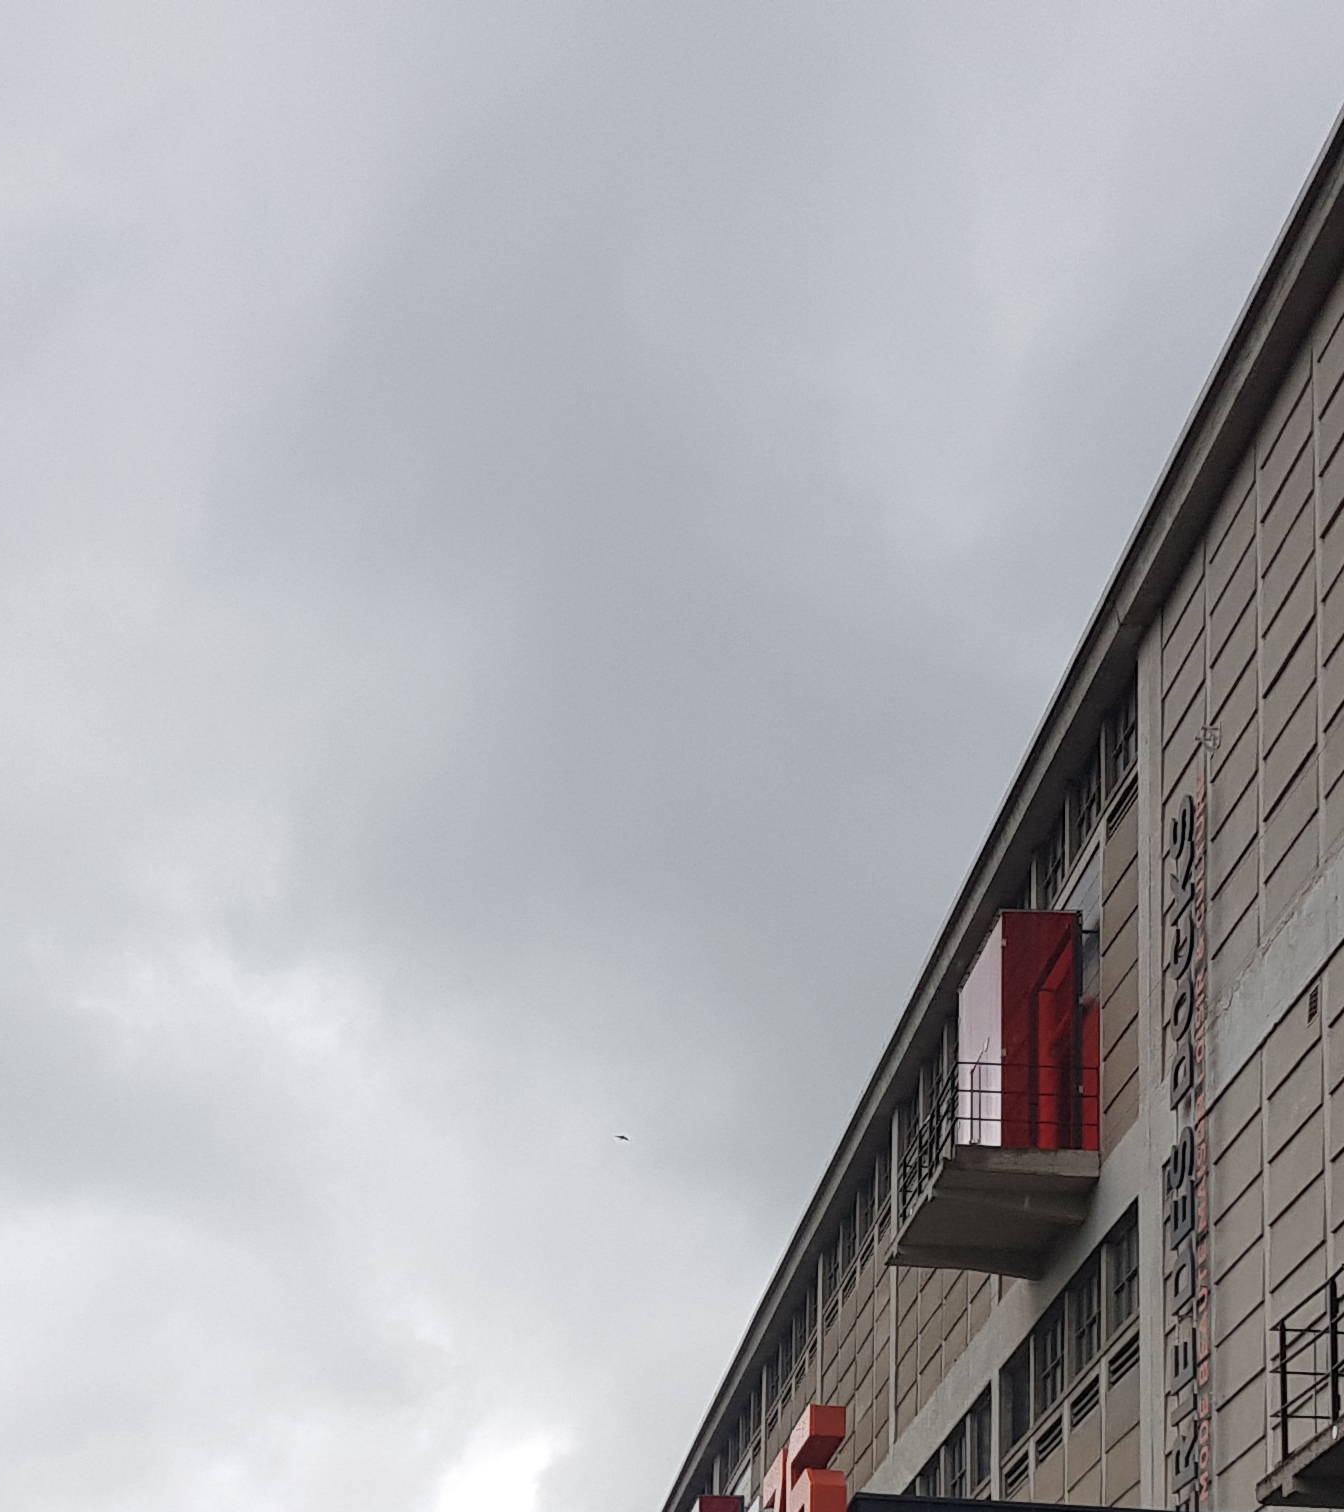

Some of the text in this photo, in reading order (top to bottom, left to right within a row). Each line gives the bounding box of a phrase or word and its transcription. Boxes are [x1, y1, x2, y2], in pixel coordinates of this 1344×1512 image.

[1169, 795, 1194, 1110] DOCKS
[1169, 1126, 1195, 1316] DES
[1198, 1394, 1209, 1502] MODE
